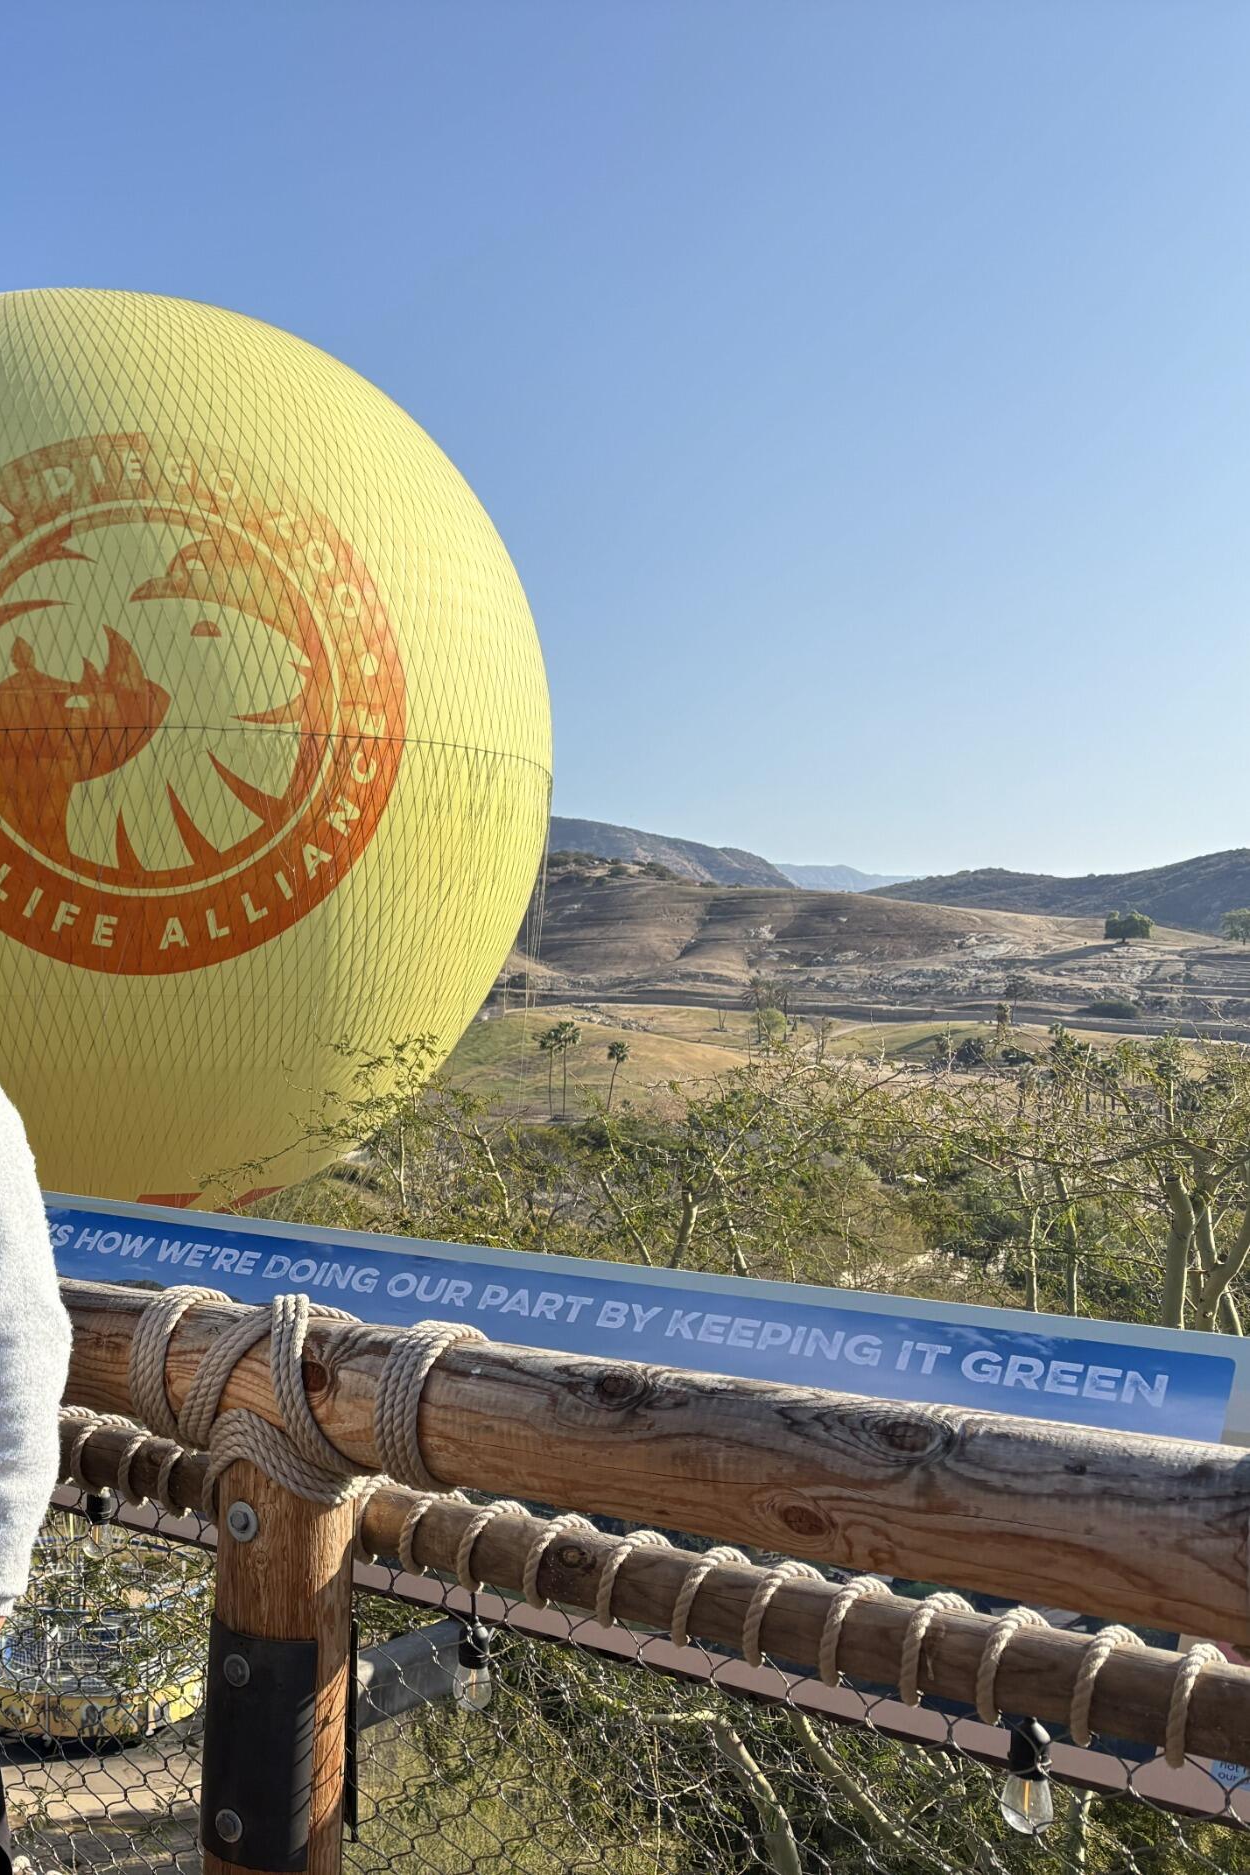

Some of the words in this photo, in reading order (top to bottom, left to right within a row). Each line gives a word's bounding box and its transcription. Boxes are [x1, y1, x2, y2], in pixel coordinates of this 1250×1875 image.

[41, 450, 242, 499] DIEGO
[262, 506, 363, 618] ZOO
[158, 709, 385, 951] ALLIANCE
[73, 1228, 155, 1259] HOW
[159, 1240, 261, 1276] WE'RE
[262, 1253, 380, 1294] DOING
[387, 1272, 473, 1307] OUR
[476, 1283, 592, 1322] PART
[596, 1300, 663, 1333] BY
[665, 1308, 883, 1366] KEEPING
[894, 1339, 952, 1376] IT
[961, 1350, 1170, 1408] GREEN
